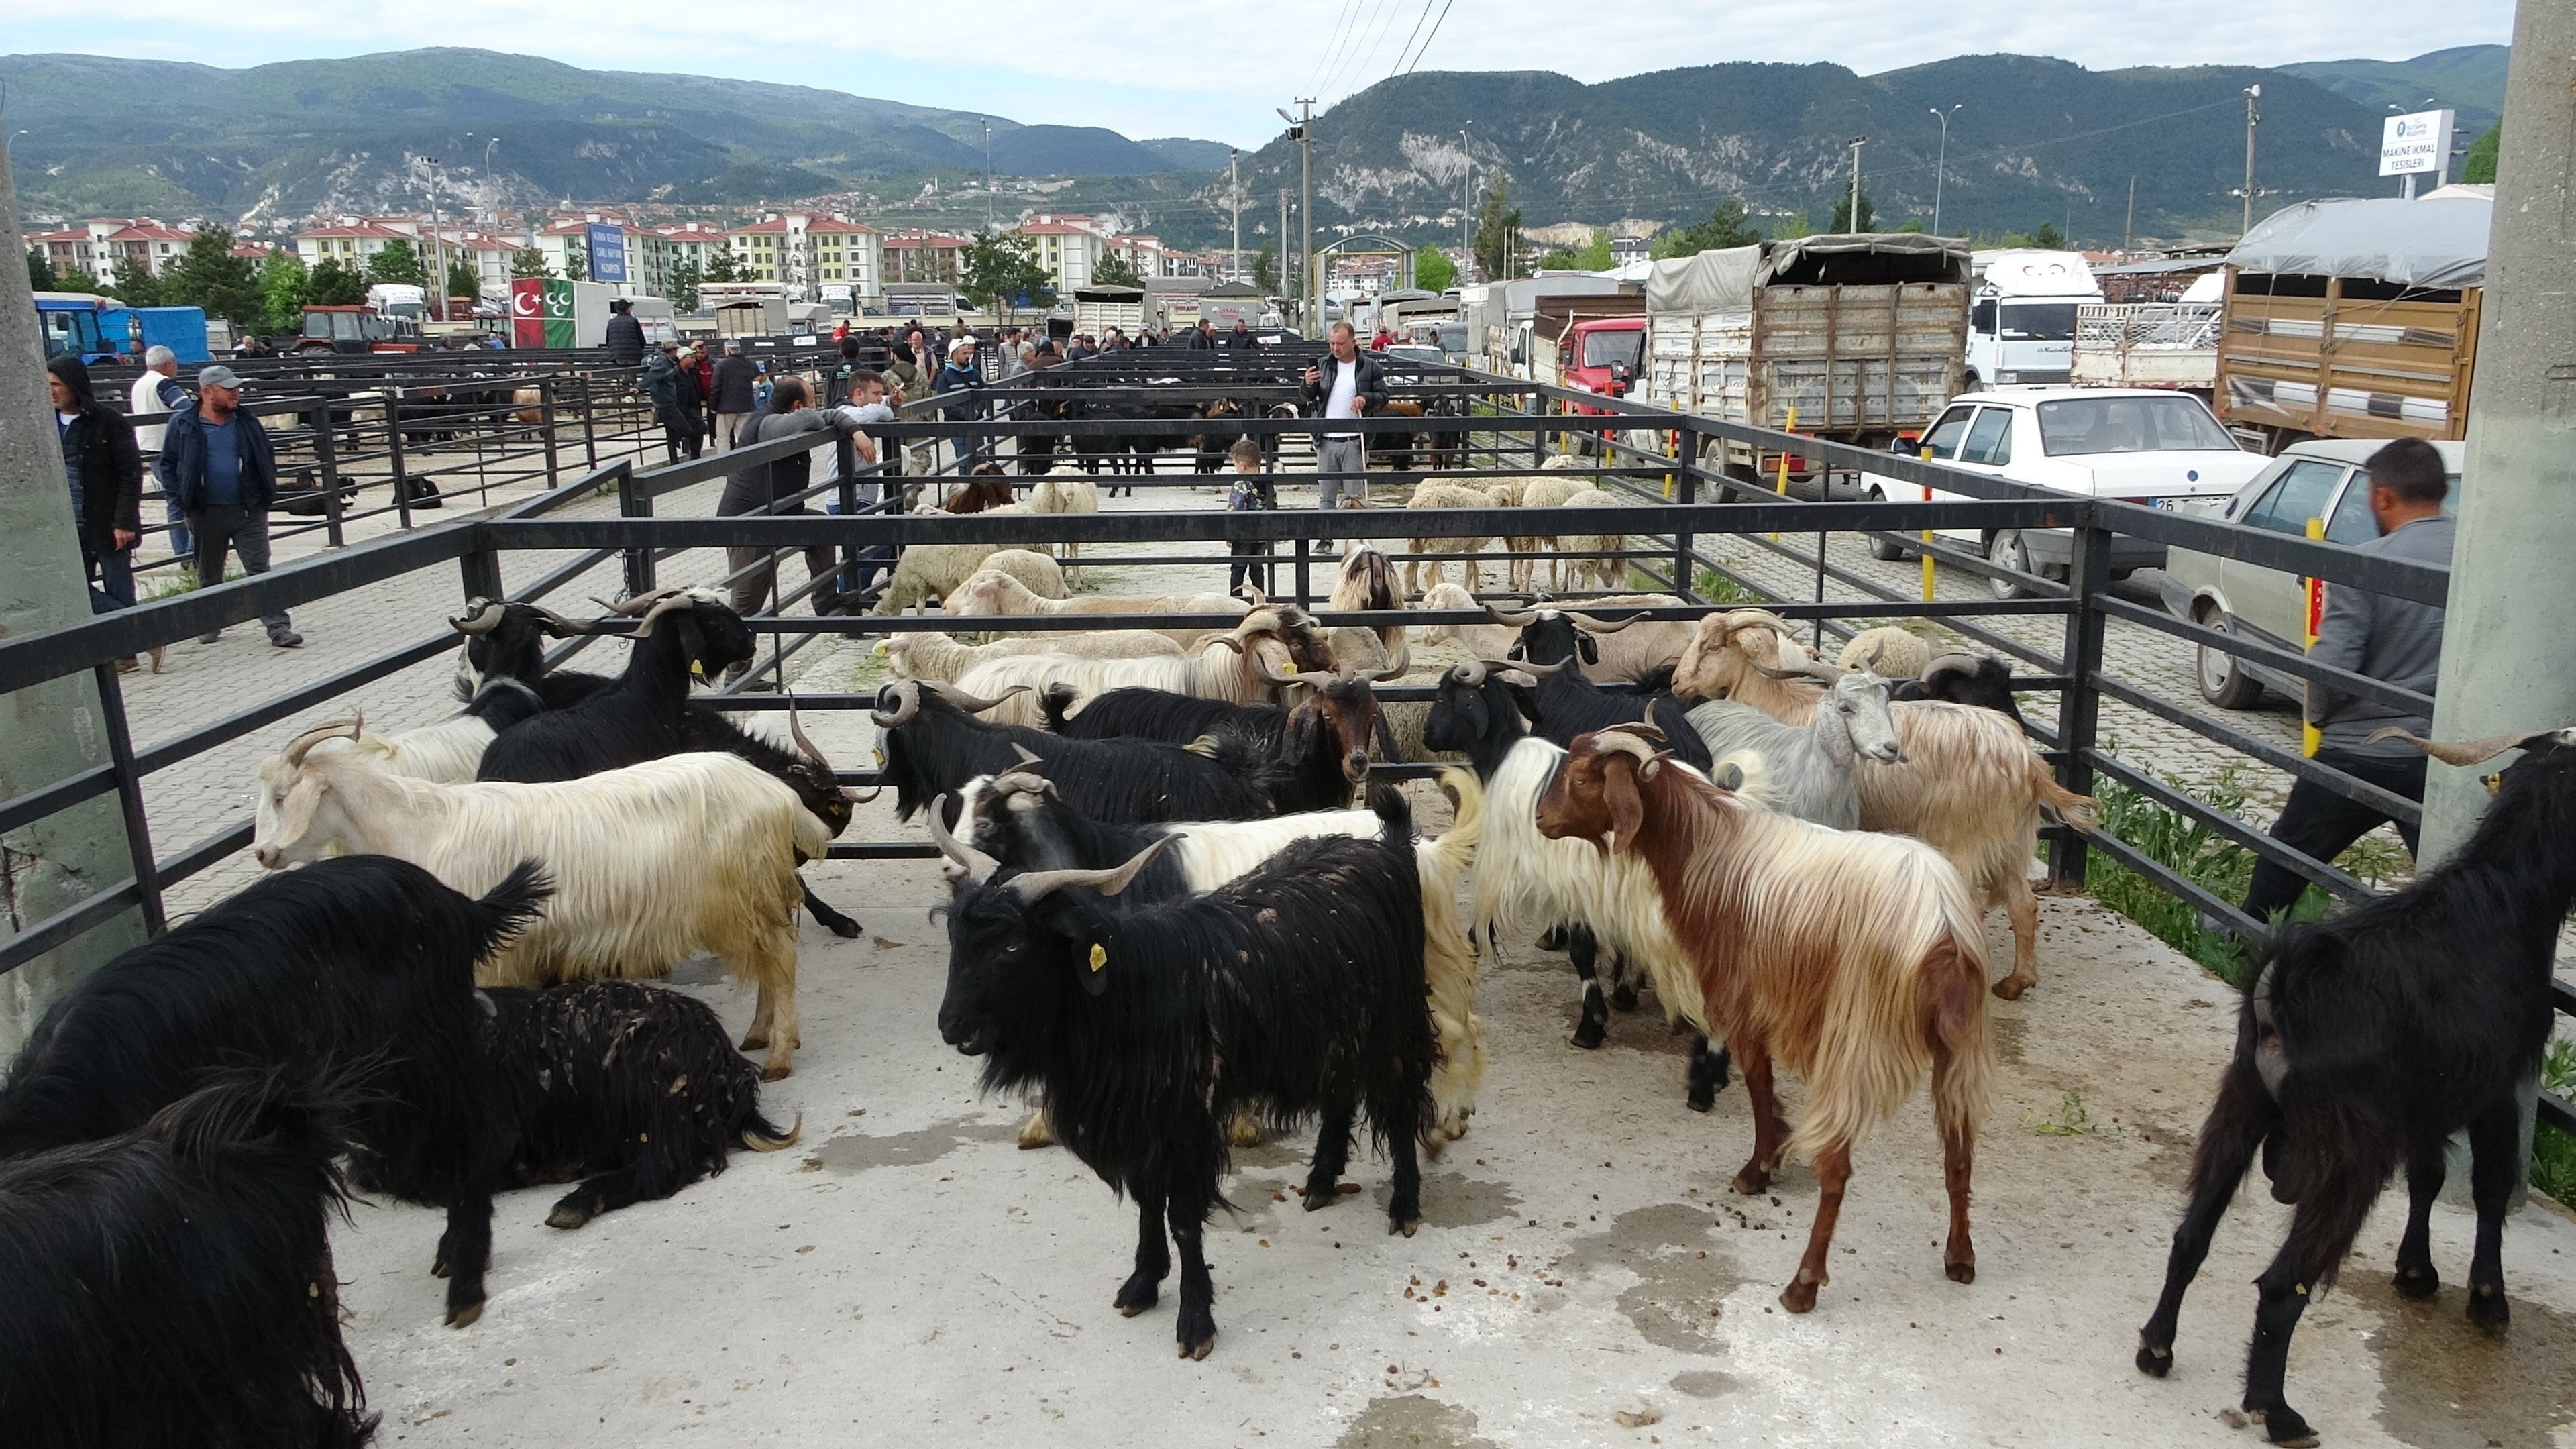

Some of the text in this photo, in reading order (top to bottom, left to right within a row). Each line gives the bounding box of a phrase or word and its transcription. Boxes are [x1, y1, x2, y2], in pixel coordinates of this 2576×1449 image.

[2382, 143, 2435, 158] MAKİNE İKMAL
[2391, 158, 2424, 170] TESİSLERİ
